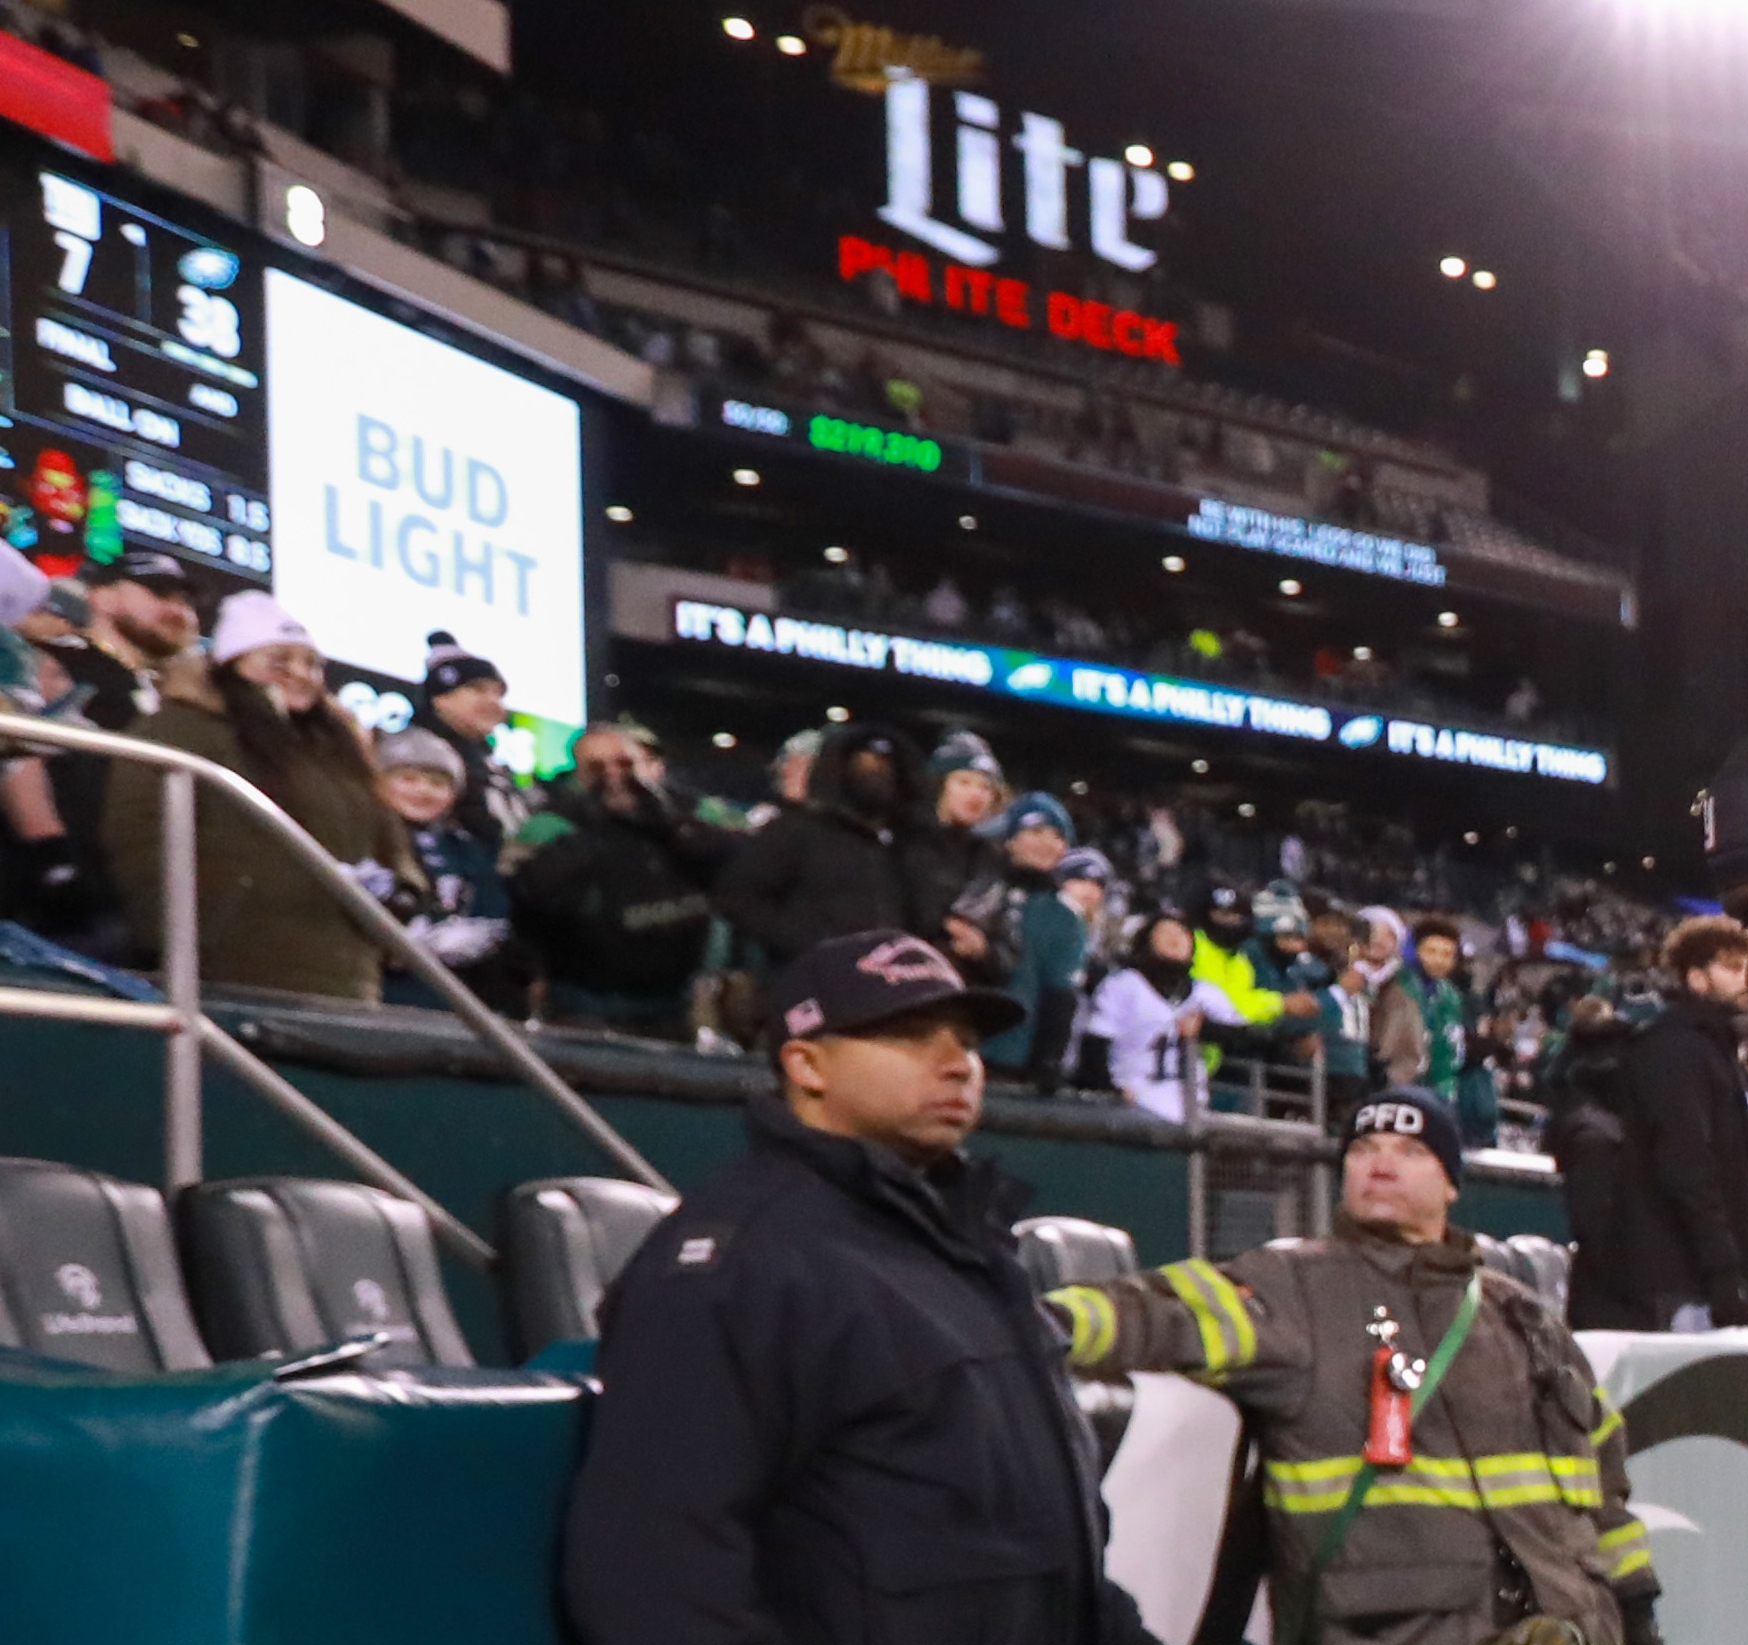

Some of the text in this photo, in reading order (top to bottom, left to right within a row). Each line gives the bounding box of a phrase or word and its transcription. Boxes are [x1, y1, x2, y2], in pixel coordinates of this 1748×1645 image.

[878, 66, 1169, 272] Lite
[55, 231, 92, 294] 7
[1047, 292, 1181, 365] DECK
[357, 412, 508, 528] BUD
[324, 483, 536, 616] LIGHT
[676, 600, 993, 686] IT'S A PHILLY THING
[1072, 668, 1331, 740] IT'S A PHILLY THING
[1388, 720, 1435, 757] IT'S
[1436, 728, 1455, 761] A
[1355, 1102, 1423, 1134] PFD
